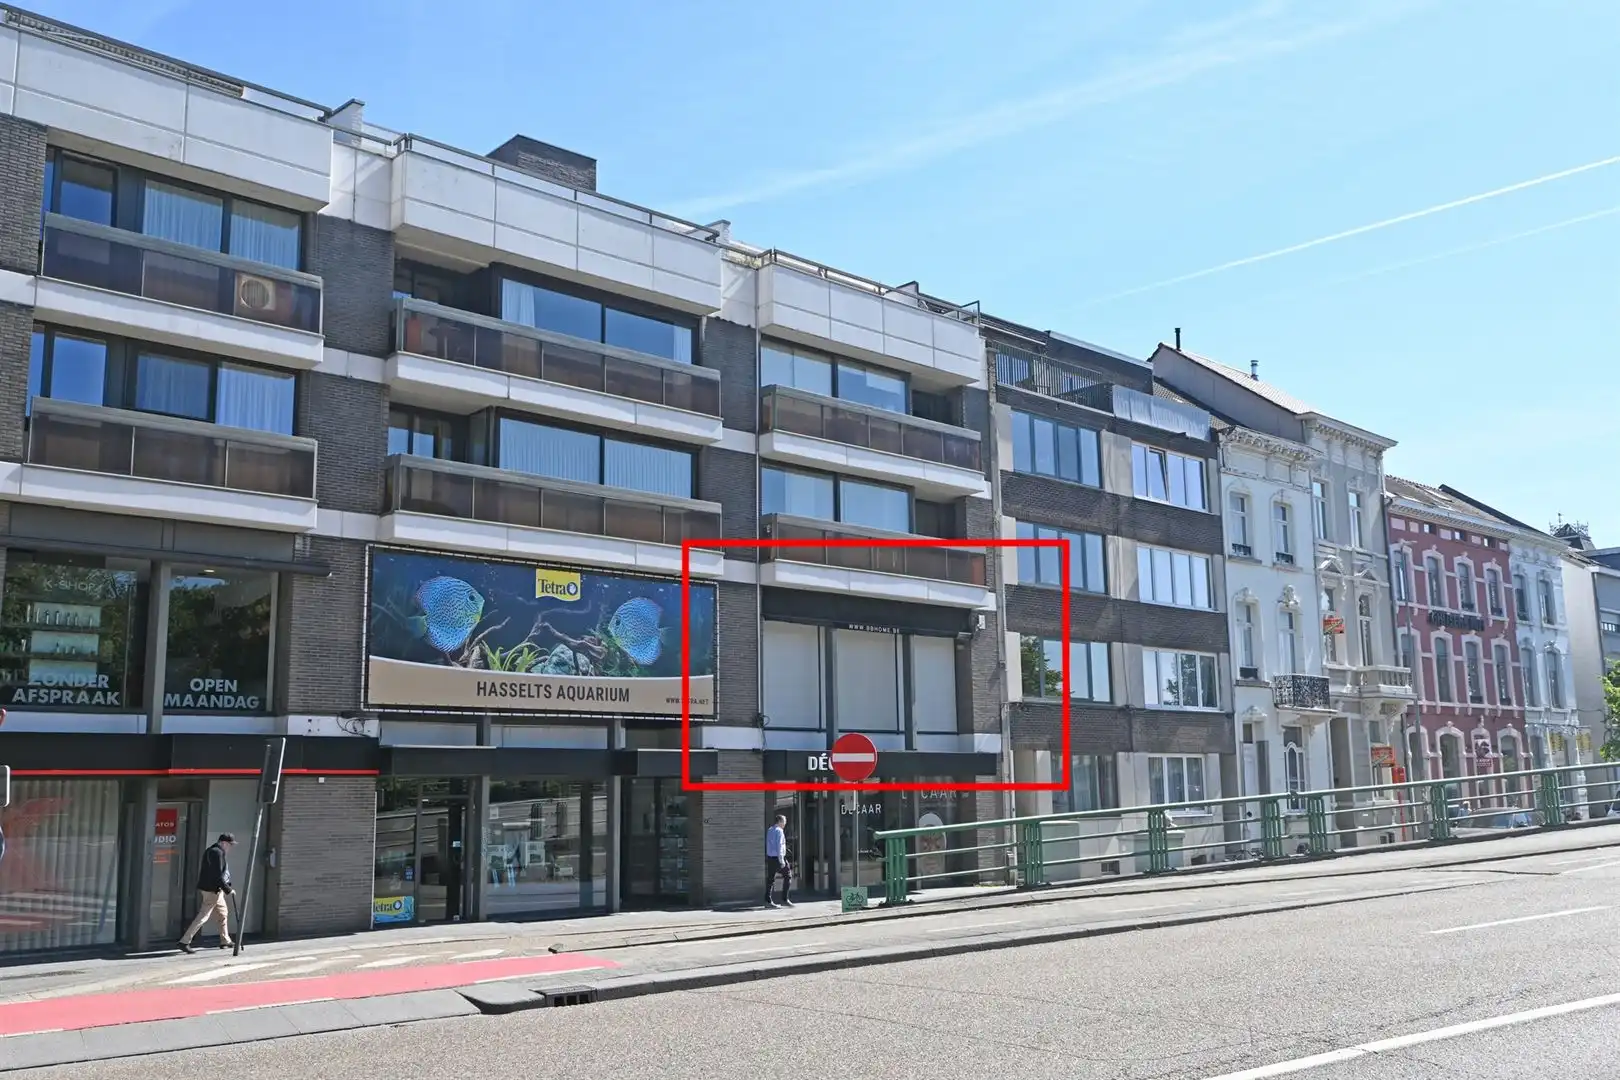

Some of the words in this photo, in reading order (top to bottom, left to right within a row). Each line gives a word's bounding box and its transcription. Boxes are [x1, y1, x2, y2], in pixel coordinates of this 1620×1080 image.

[537, 578, 566, 595] Tetra
[28, 673, 109, 688] ZONDER
[189, 678, 238, 692] OPEN
[12, 689, 120, 705] AFSPRAAK
[476, 681, 552, 698] HASSELTS
[556, 685, 630, 702] AQUARIUM
[164, 693, 260, 708] MAANDAG
